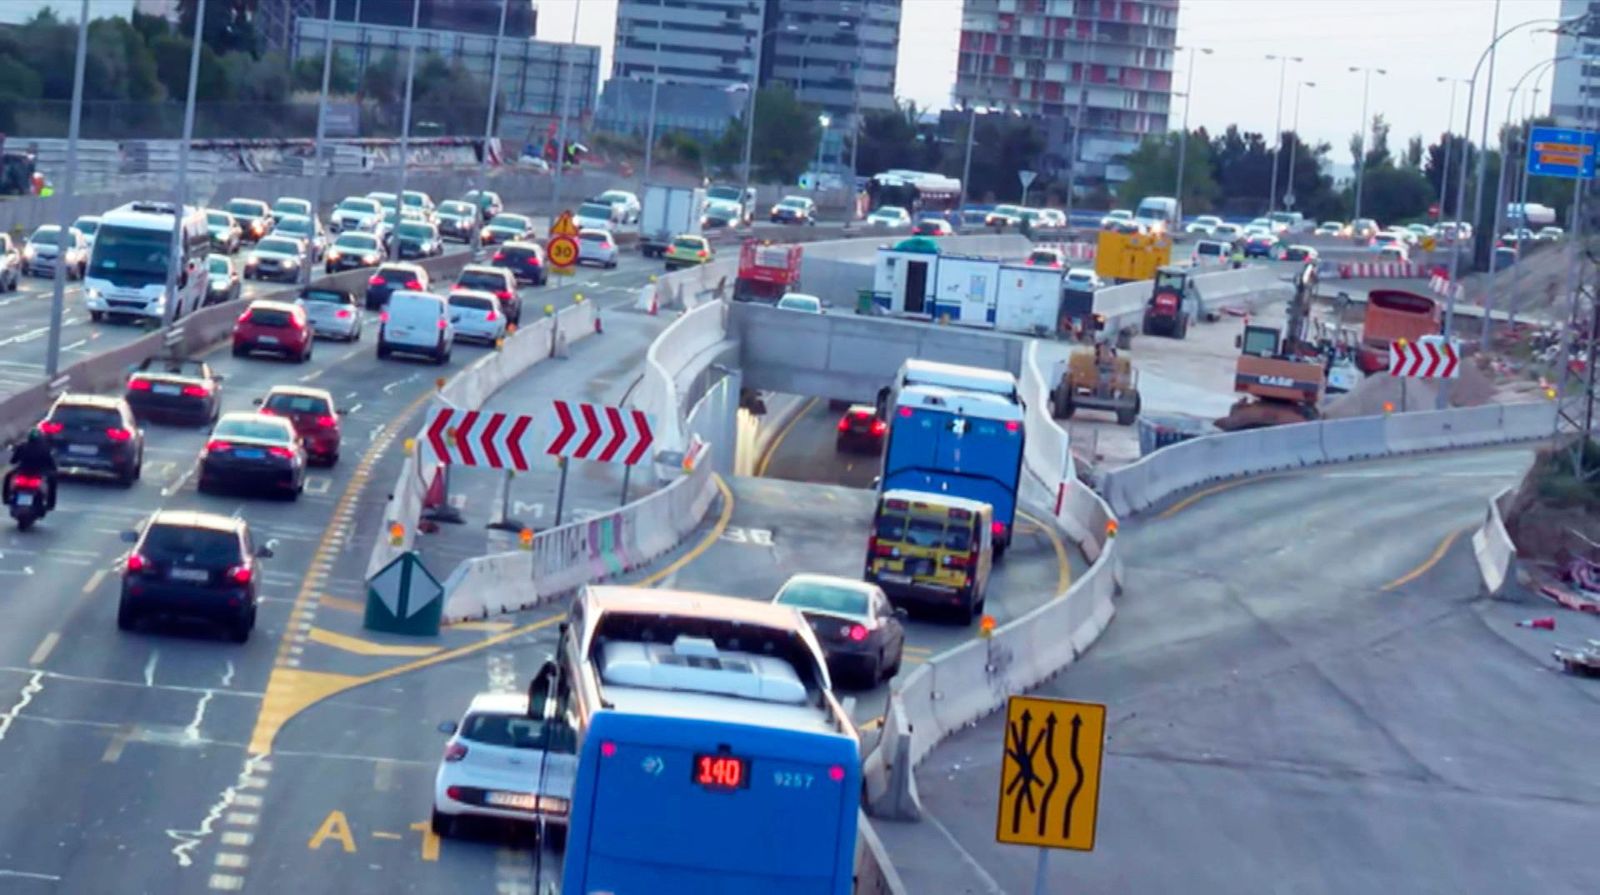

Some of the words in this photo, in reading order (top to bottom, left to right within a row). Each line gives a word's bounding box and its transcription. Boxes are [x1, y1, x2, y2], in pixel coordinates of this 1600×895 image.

[553, 244, 573, 258] 30
[1259, 374, 1294, 387] CASE
[699, 756, 740, 786] 140
[773, 770, 815, 789] 9257
